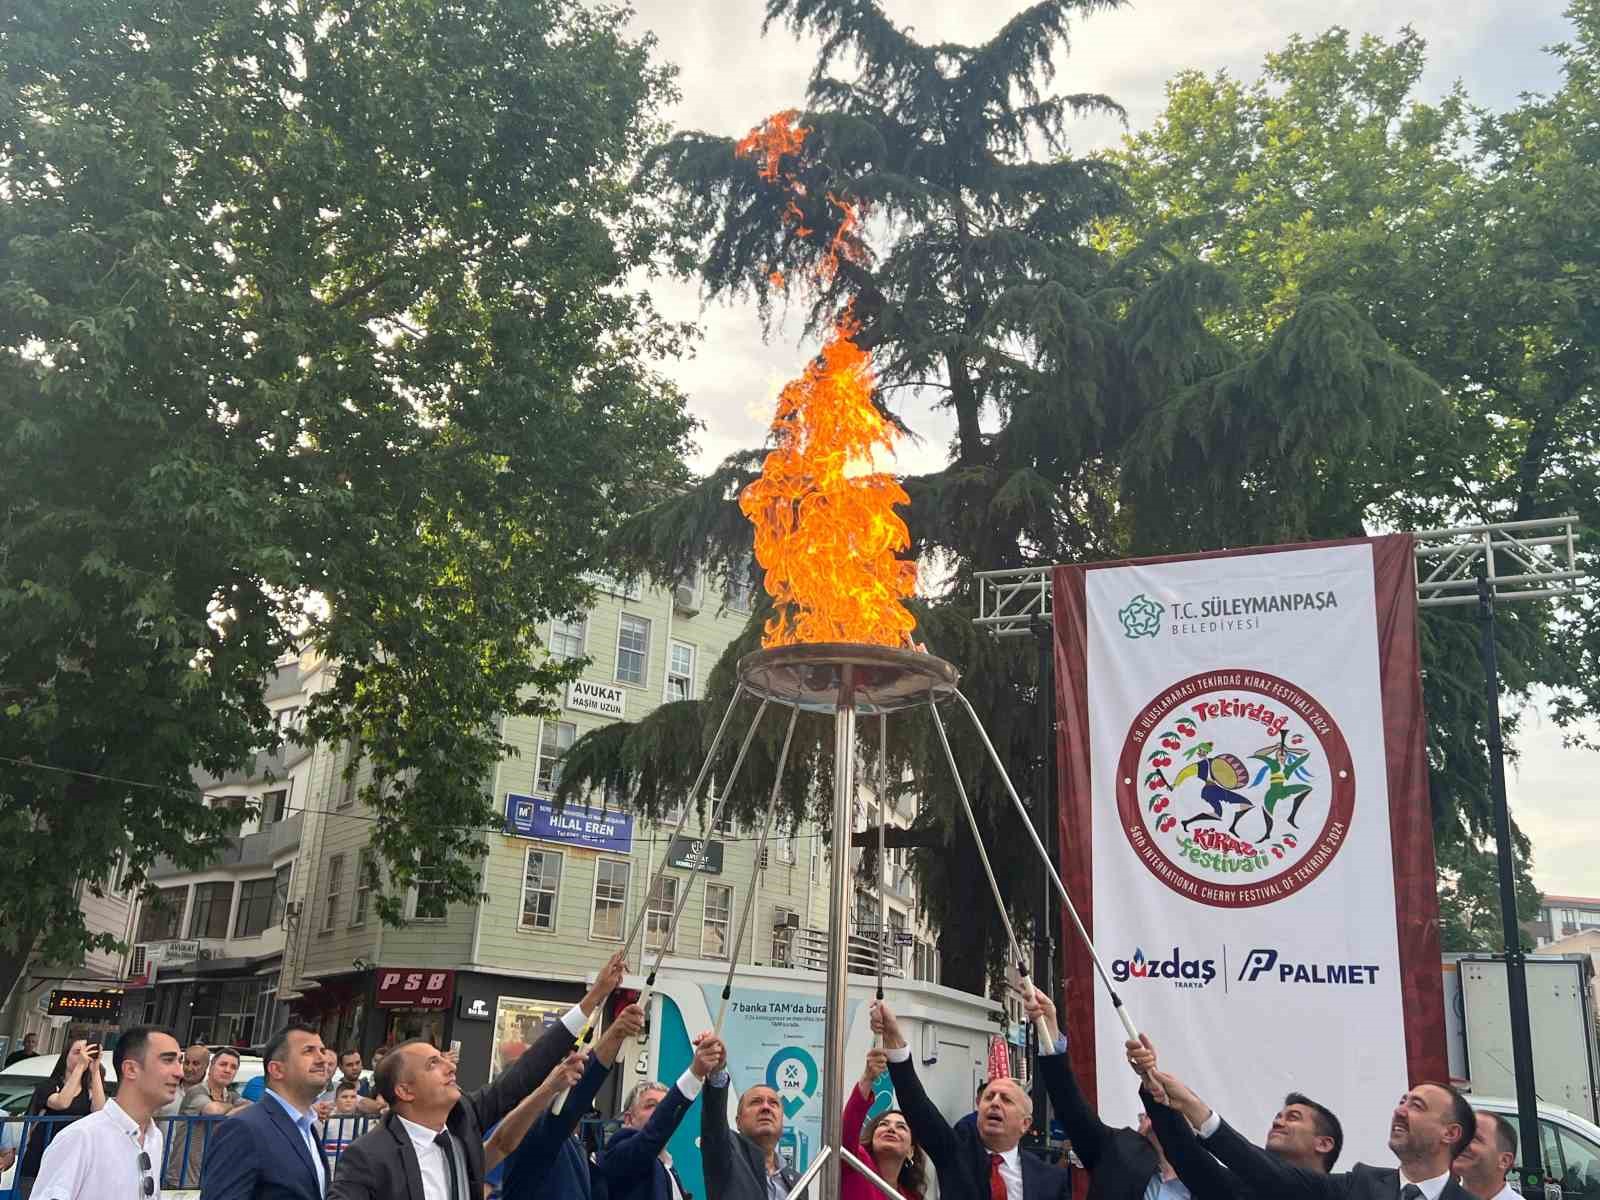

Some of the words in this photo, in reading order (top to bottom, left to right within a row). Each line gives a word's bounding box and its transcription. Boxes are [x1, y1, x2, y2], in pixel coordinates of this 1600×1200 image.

[1171, 602, 1198, 620] T.C.
[1201, 591, 1338, 617] SÜLEYMANPAŞA
[1172, 617, 1259, 635] BELEDİYESİ
[574, 682, 622, 702] AVUKAT
[600, 701, 621, 713] UZUN
[1191, 698, 1289, 737] Tekirdağ
[1310, 712, 1330, 735] 2024
[549, 813, 582, 831] HİLAL
[585, 821, 614, 837] EREN
[1143, 846, 1198, 896] INTERNATIONAL
[1201, 887, 1236, 902] CHERRY
[1240, 883, 1281, 902] FESTIVAL
[1283, 876, 1297, 890] OF
[1326, 821, 1345, 846] 2024
[1279, 963, 1380, 985] PALMET
[731, 1002, 738, 1012] 7
[739, 1001, 767, 1013] banka
[768, 1003, 804, 1014] TAM'da
[806, 1004, 828, 1015] bura
[783, 1080, 800, 1088] TAM
